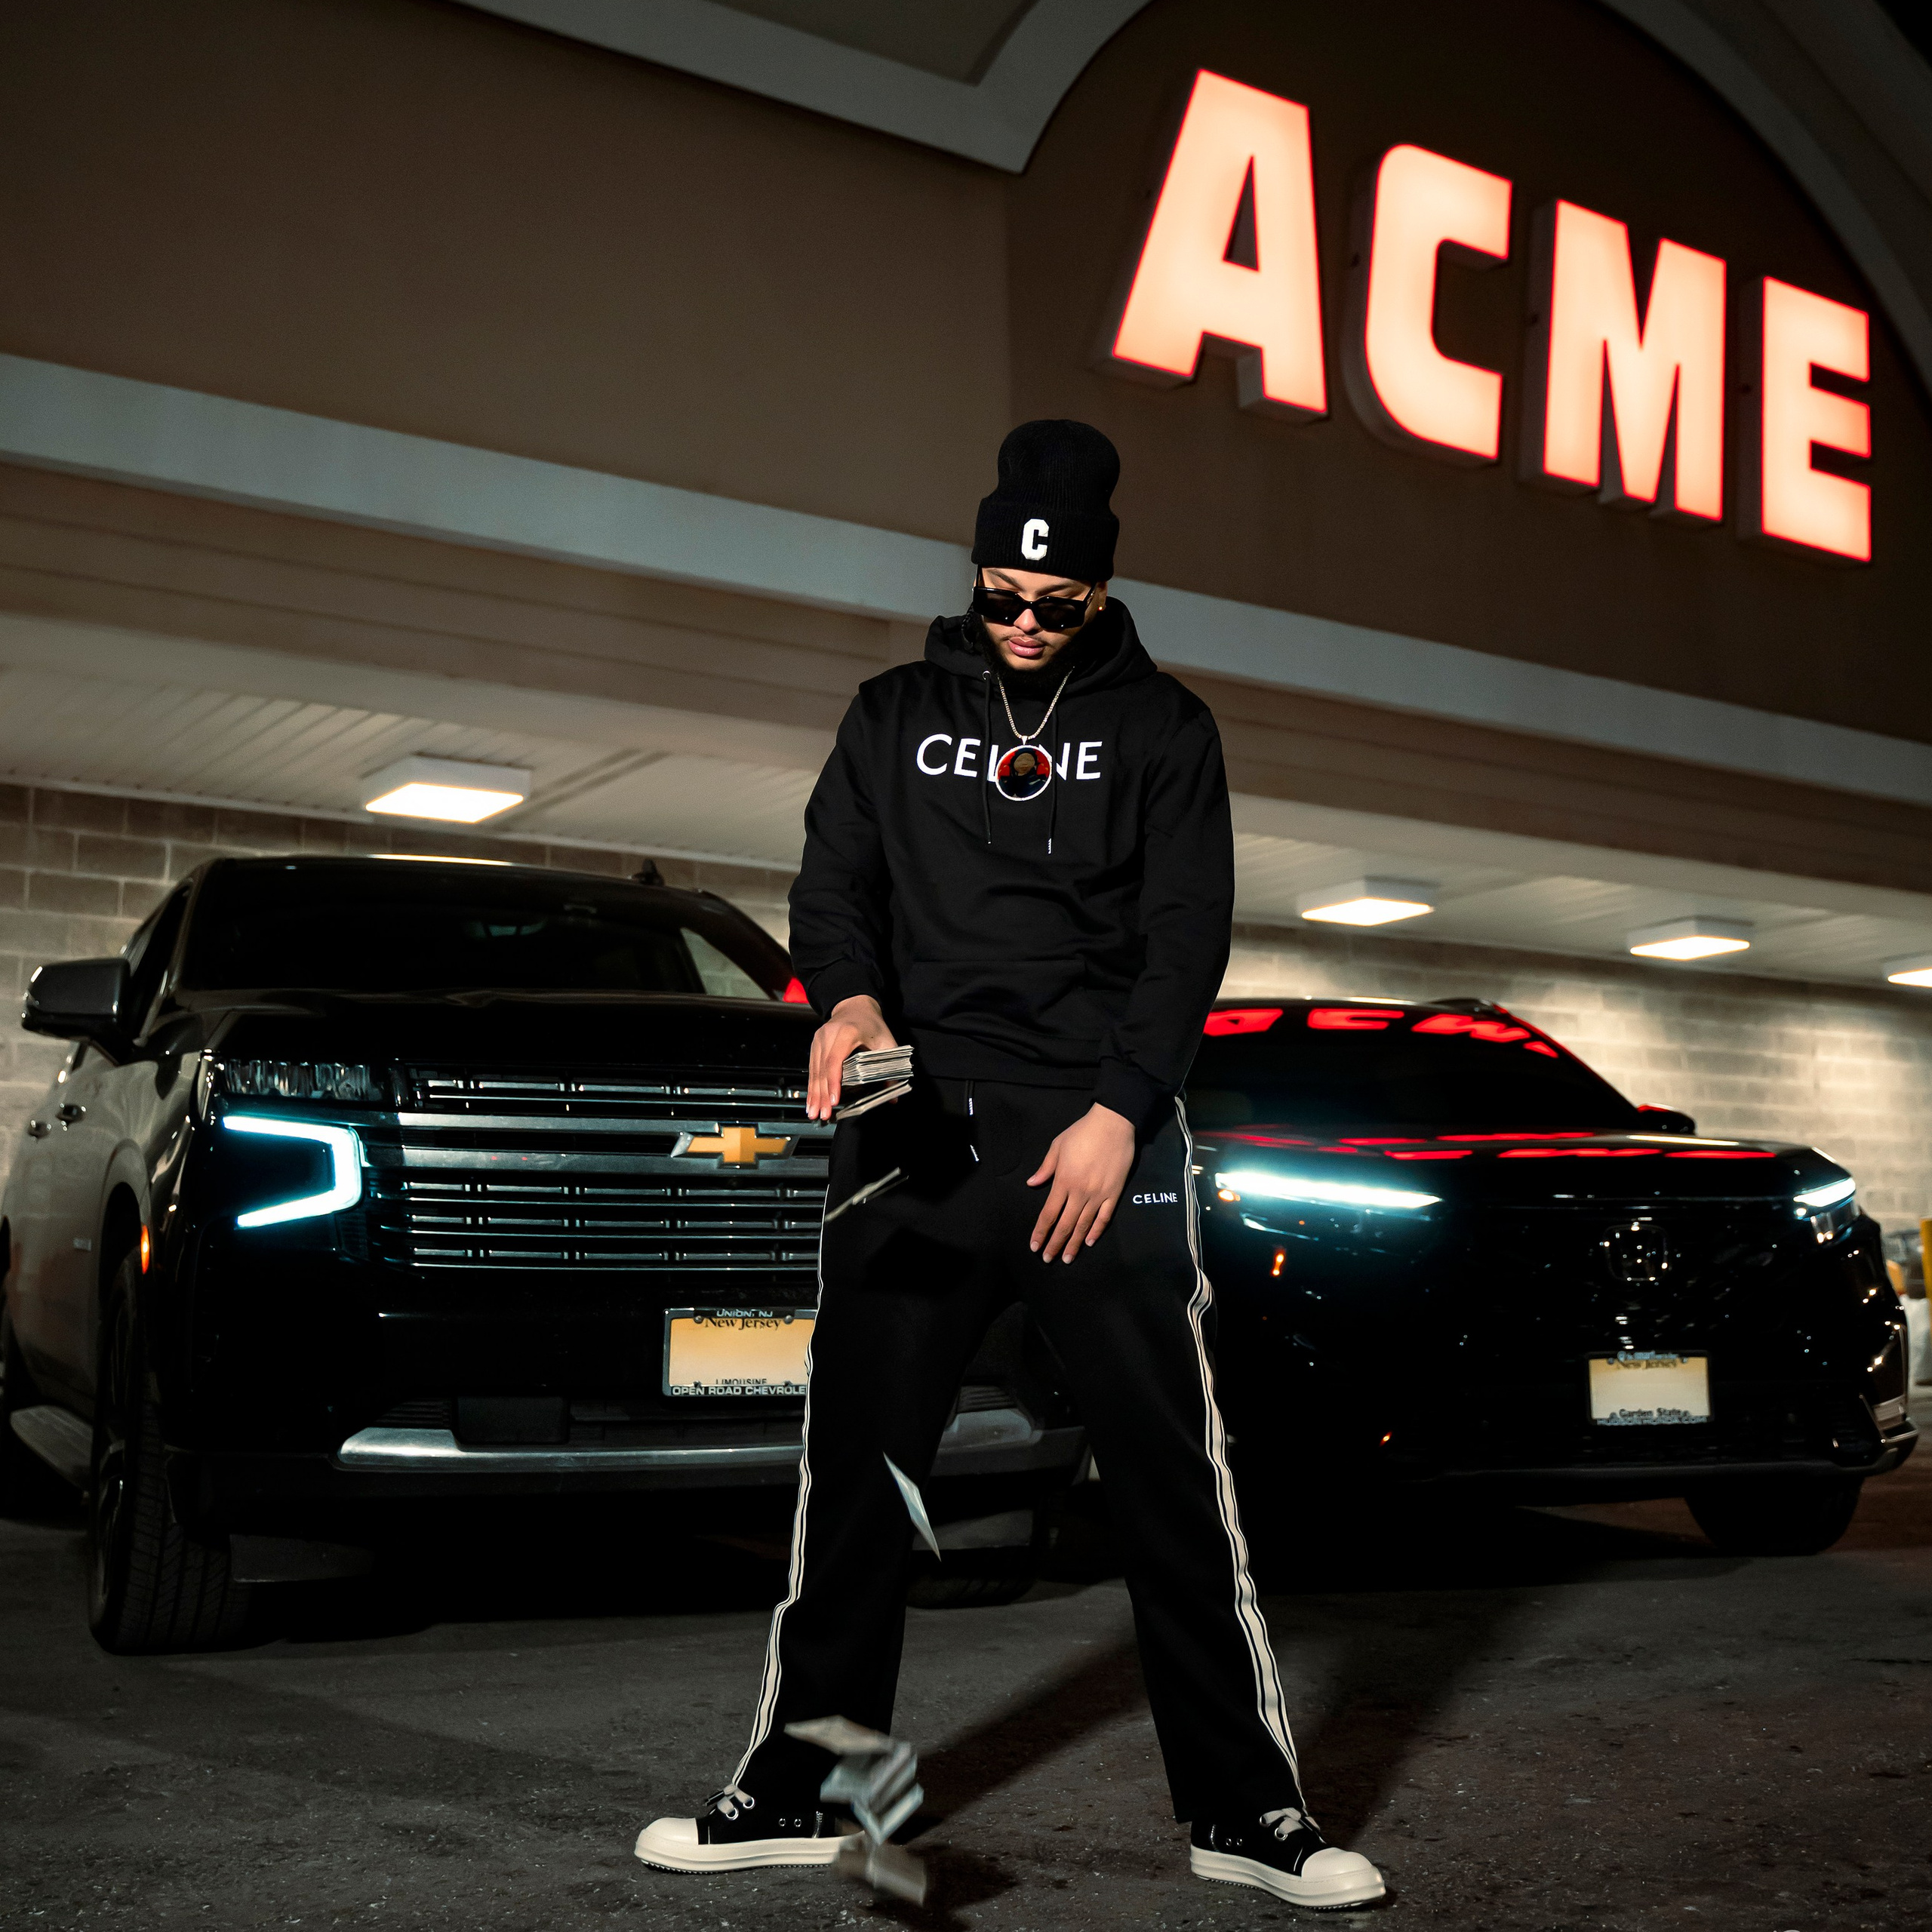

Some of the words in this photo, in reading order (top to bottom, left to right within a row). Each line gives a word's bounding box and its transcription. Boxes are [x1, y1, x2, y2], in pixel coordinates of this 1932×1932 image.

[1112, 68, 1873, 563] ACME
[1021, 518, 1050, 561] C
[916, 734, 1103, 783] CELNE
[1132, 1192, 1178, 1204] CELINE
[705, 1317, 736, 1327] New
[738, 1317, 781, 1331] Jersey
[672, 1386, 704, 1395] OPEN
[708, 1386, 742, 1395] ROAD
[745, 1386, 807, 1395] CHEVROLE
